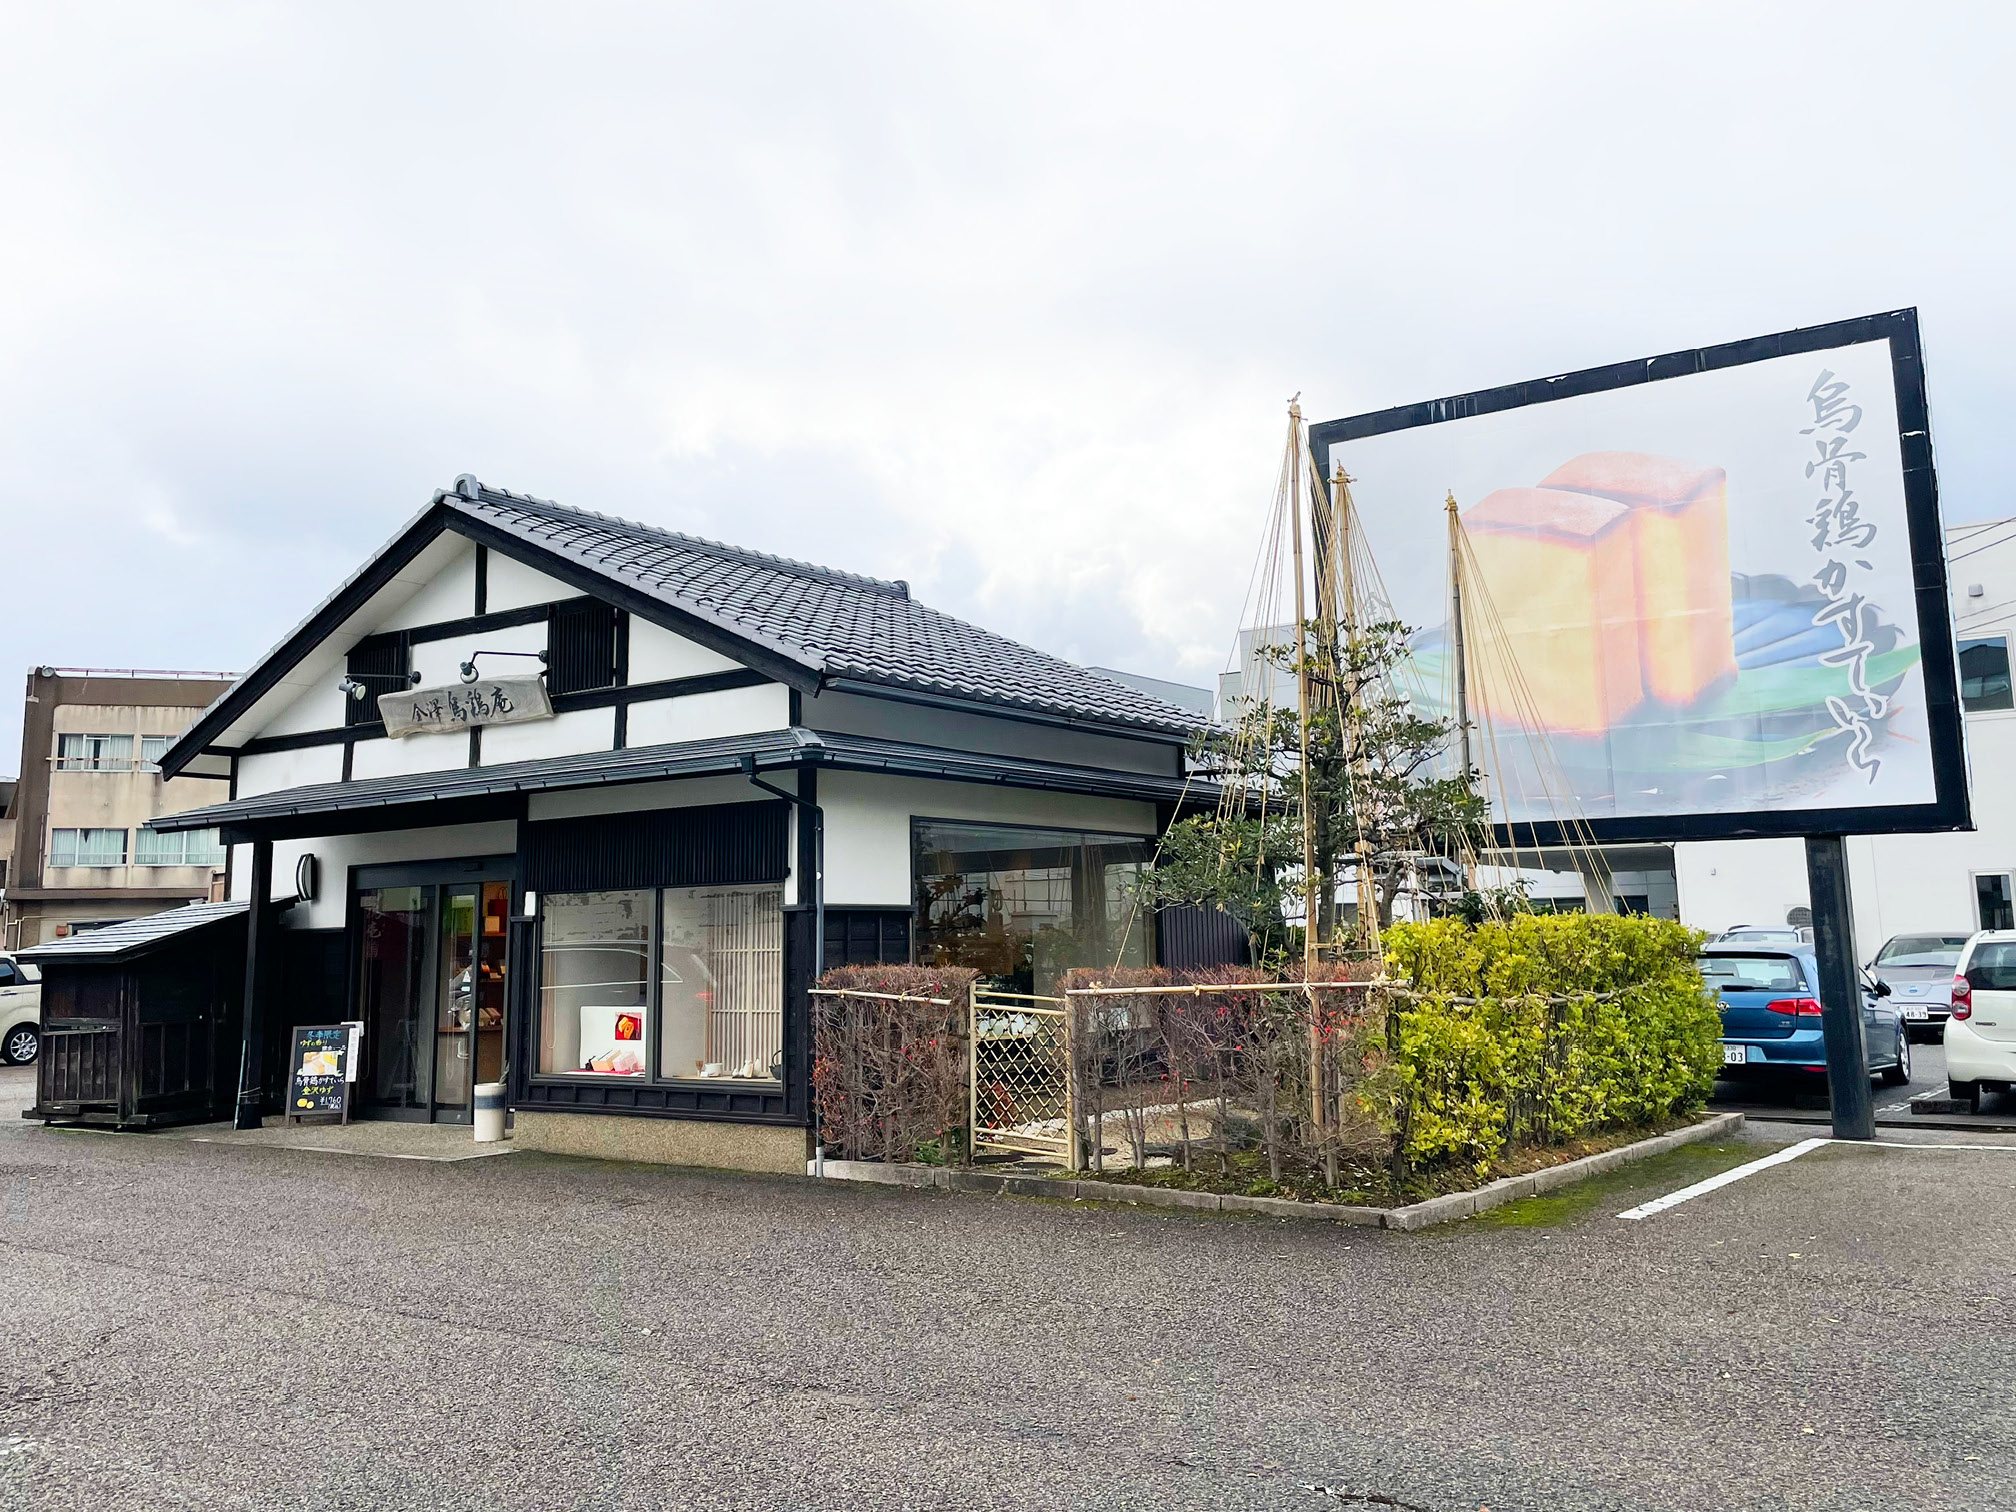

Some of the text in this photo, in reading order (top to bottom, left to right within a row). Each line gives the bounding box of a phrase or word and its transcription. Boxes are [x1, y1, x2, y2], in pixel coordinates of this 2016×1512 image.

[1799, 368, 1886, 785] 烏骨鶏かすていら
[301, 1086, 334, 1095] 金沢ゆず
